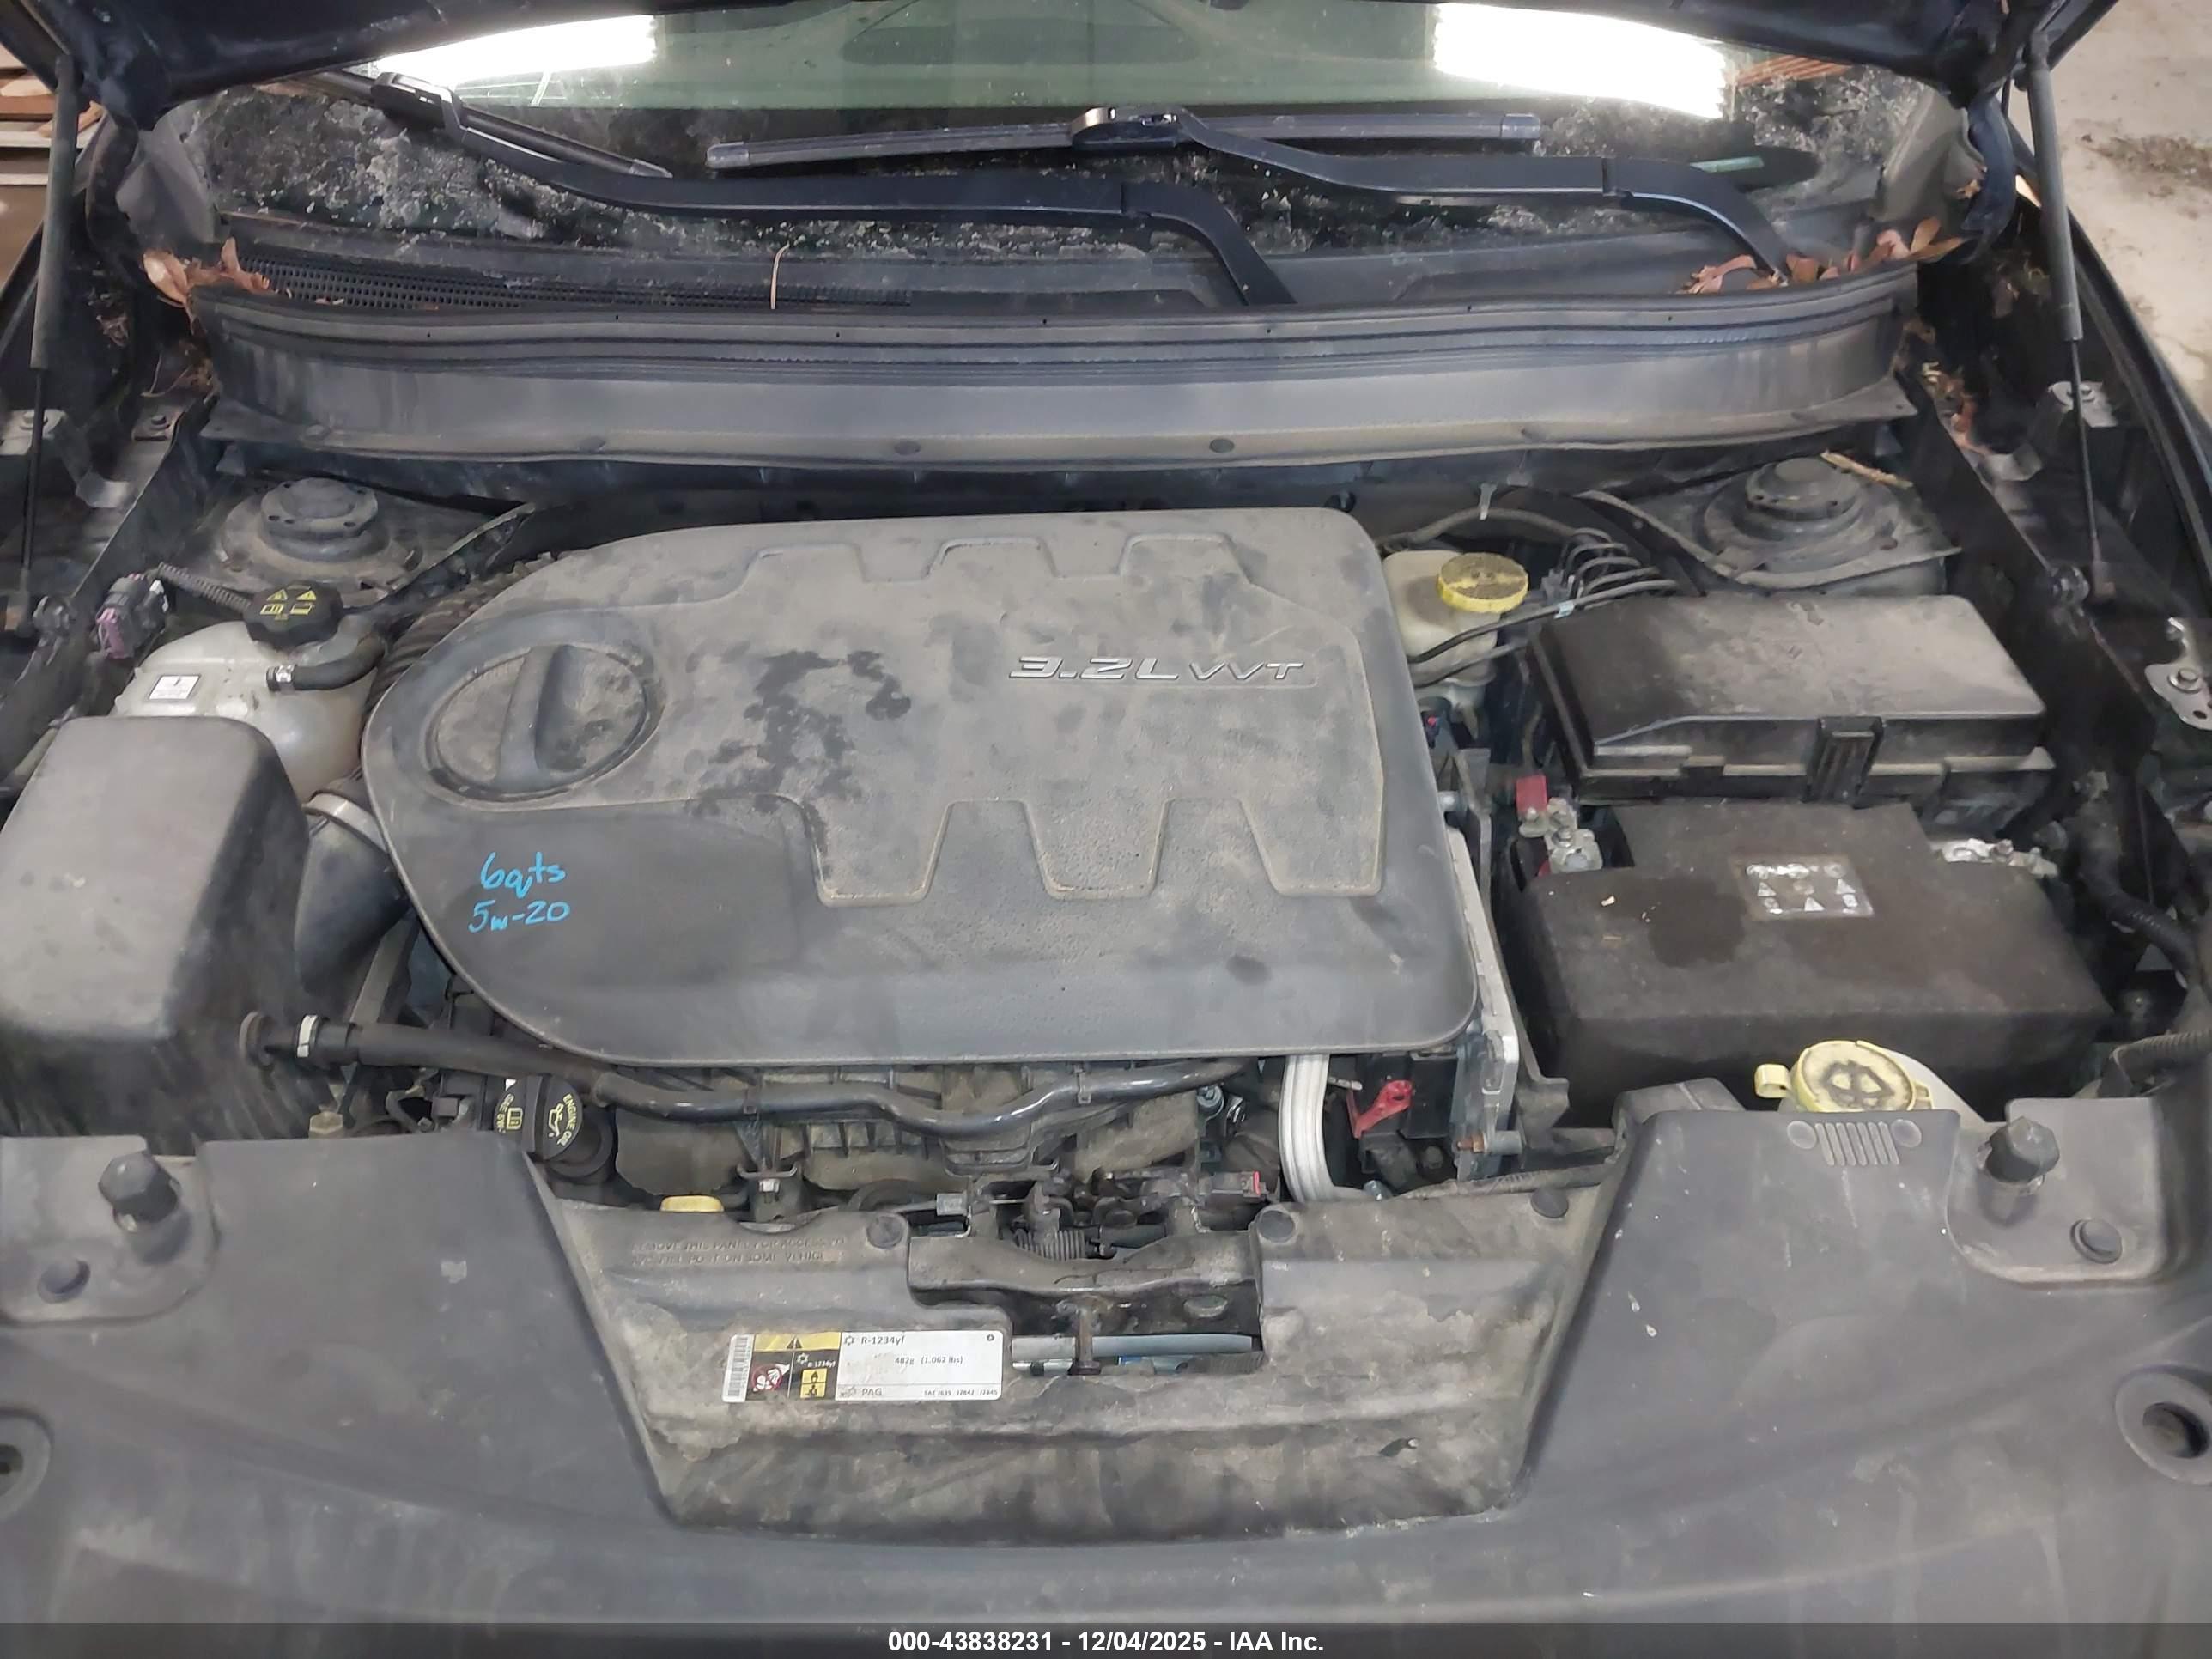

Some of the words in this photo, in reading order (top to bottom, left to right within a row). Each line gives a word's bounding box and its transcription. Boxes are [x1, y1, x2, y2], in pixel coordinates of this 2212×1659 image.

[1009, 656, 1179, 680] 3.2L
[1189, 661, 1305, 680] VVT
[480, 851, 567, 899] 6qts
[562, 1093, 579, 1130] ENGINE
[556, 1130, 573, 1146] OIL
[688, 1255, 720, 1265] POT
[860, 1334, 906, 1346] R-1234yf
[861, 1388, 883, 1396] PAG
